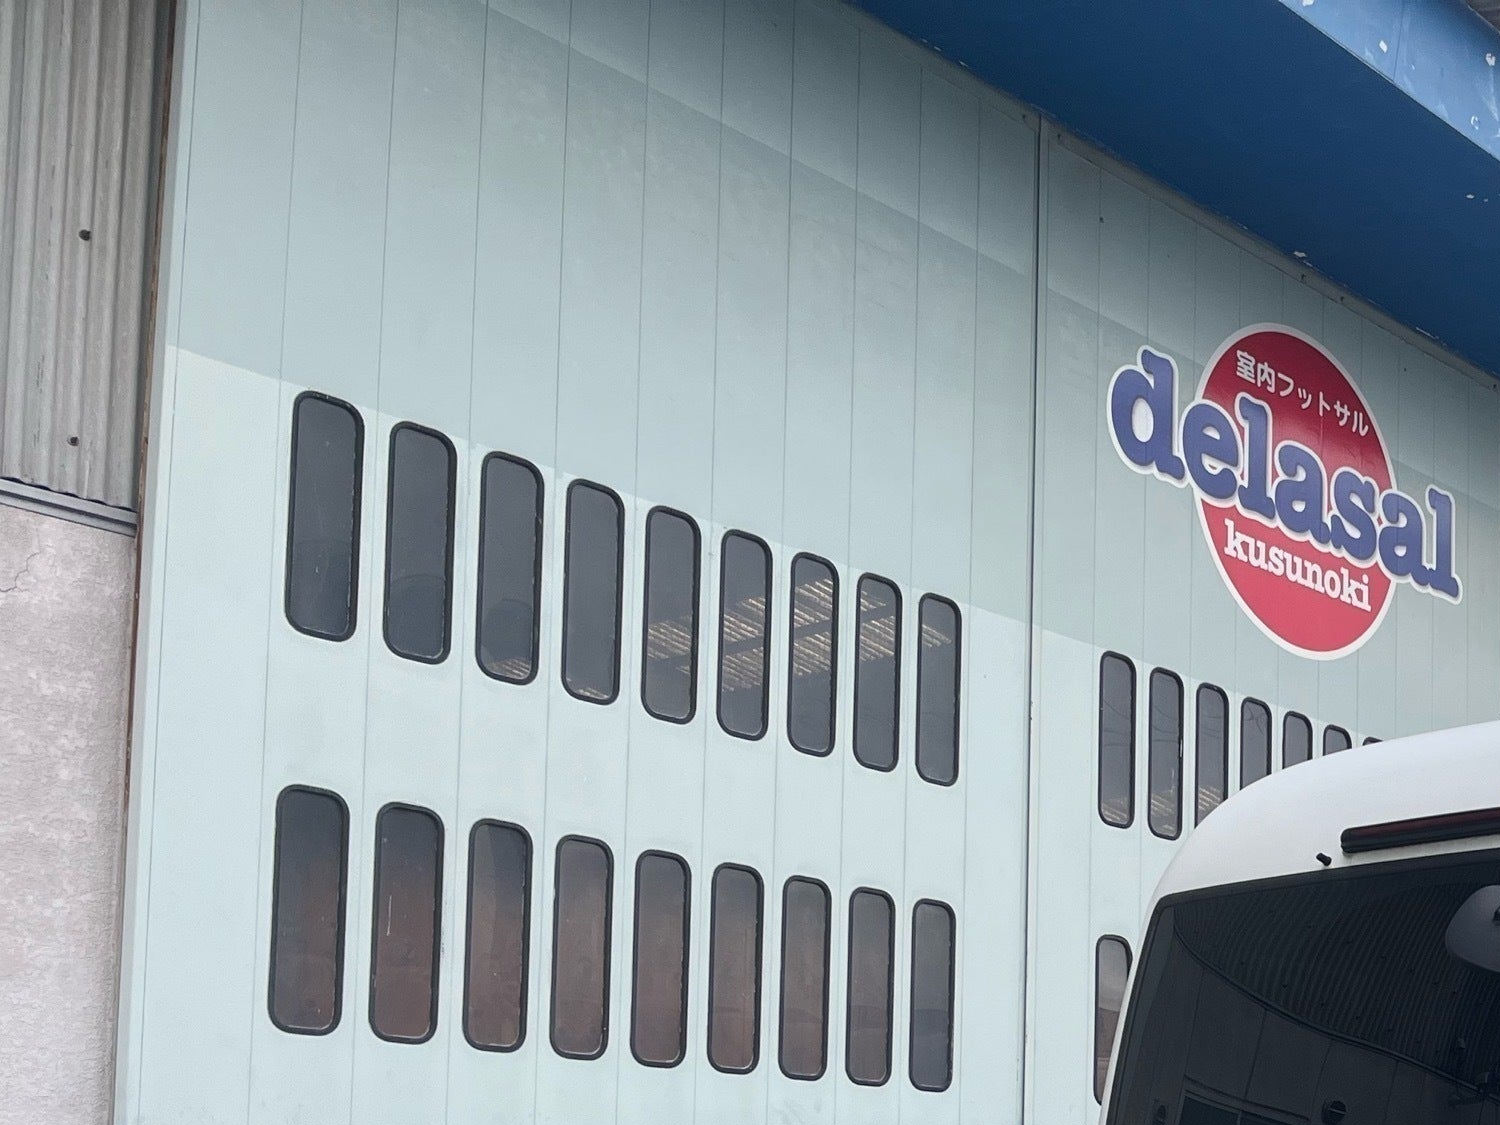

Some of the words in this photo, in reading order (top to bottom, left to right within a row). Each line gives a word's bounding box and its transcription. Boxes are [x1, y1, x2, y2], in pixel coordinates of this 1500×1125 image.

[1235, 350, 1369, 437] 室内フットサル
[1110, 347, 1461, 601] delasal
[1223, 519, 1372, 612] kusunoki
